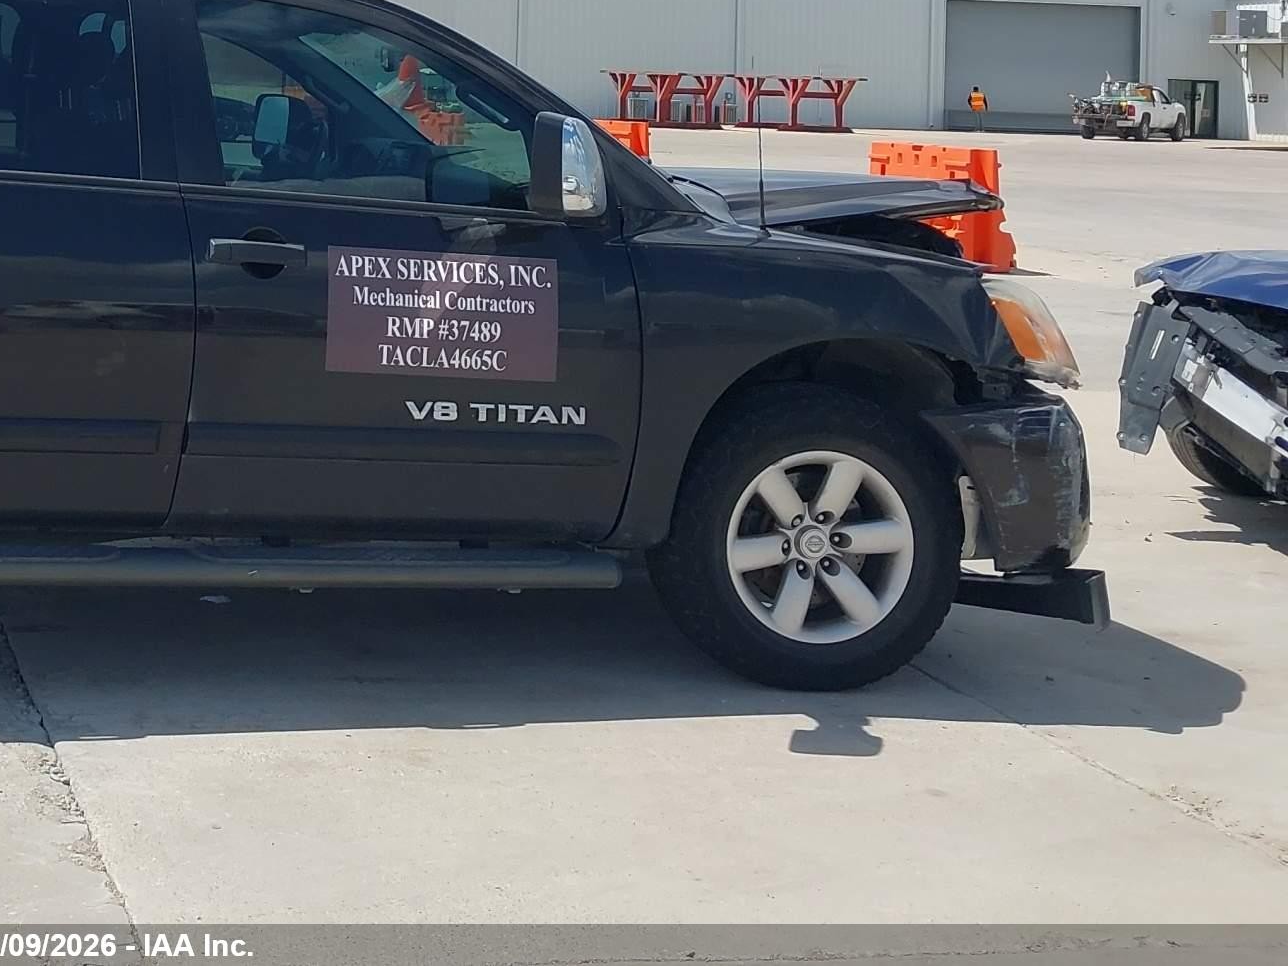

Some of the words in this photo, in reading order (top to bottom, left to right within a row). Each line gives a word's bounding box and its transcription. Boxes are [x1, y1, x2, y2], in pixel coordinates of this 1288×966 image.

[335, 254, 392, 280] APEX
[396, 258, 505, 291] SERVICES,
[509, 264, 553, 289] INC.
[352, 285, 441, 310] Mechanical
[444, 291, 536, 315] Contractors
[386, 316, 435, 339] RMP
[438, 318, 502, 343] #37489
[378, 344, 508, 372] TACLA4665C
[405, 401, 459, 421] V8
[469, 403, 587, 425] TITAN
